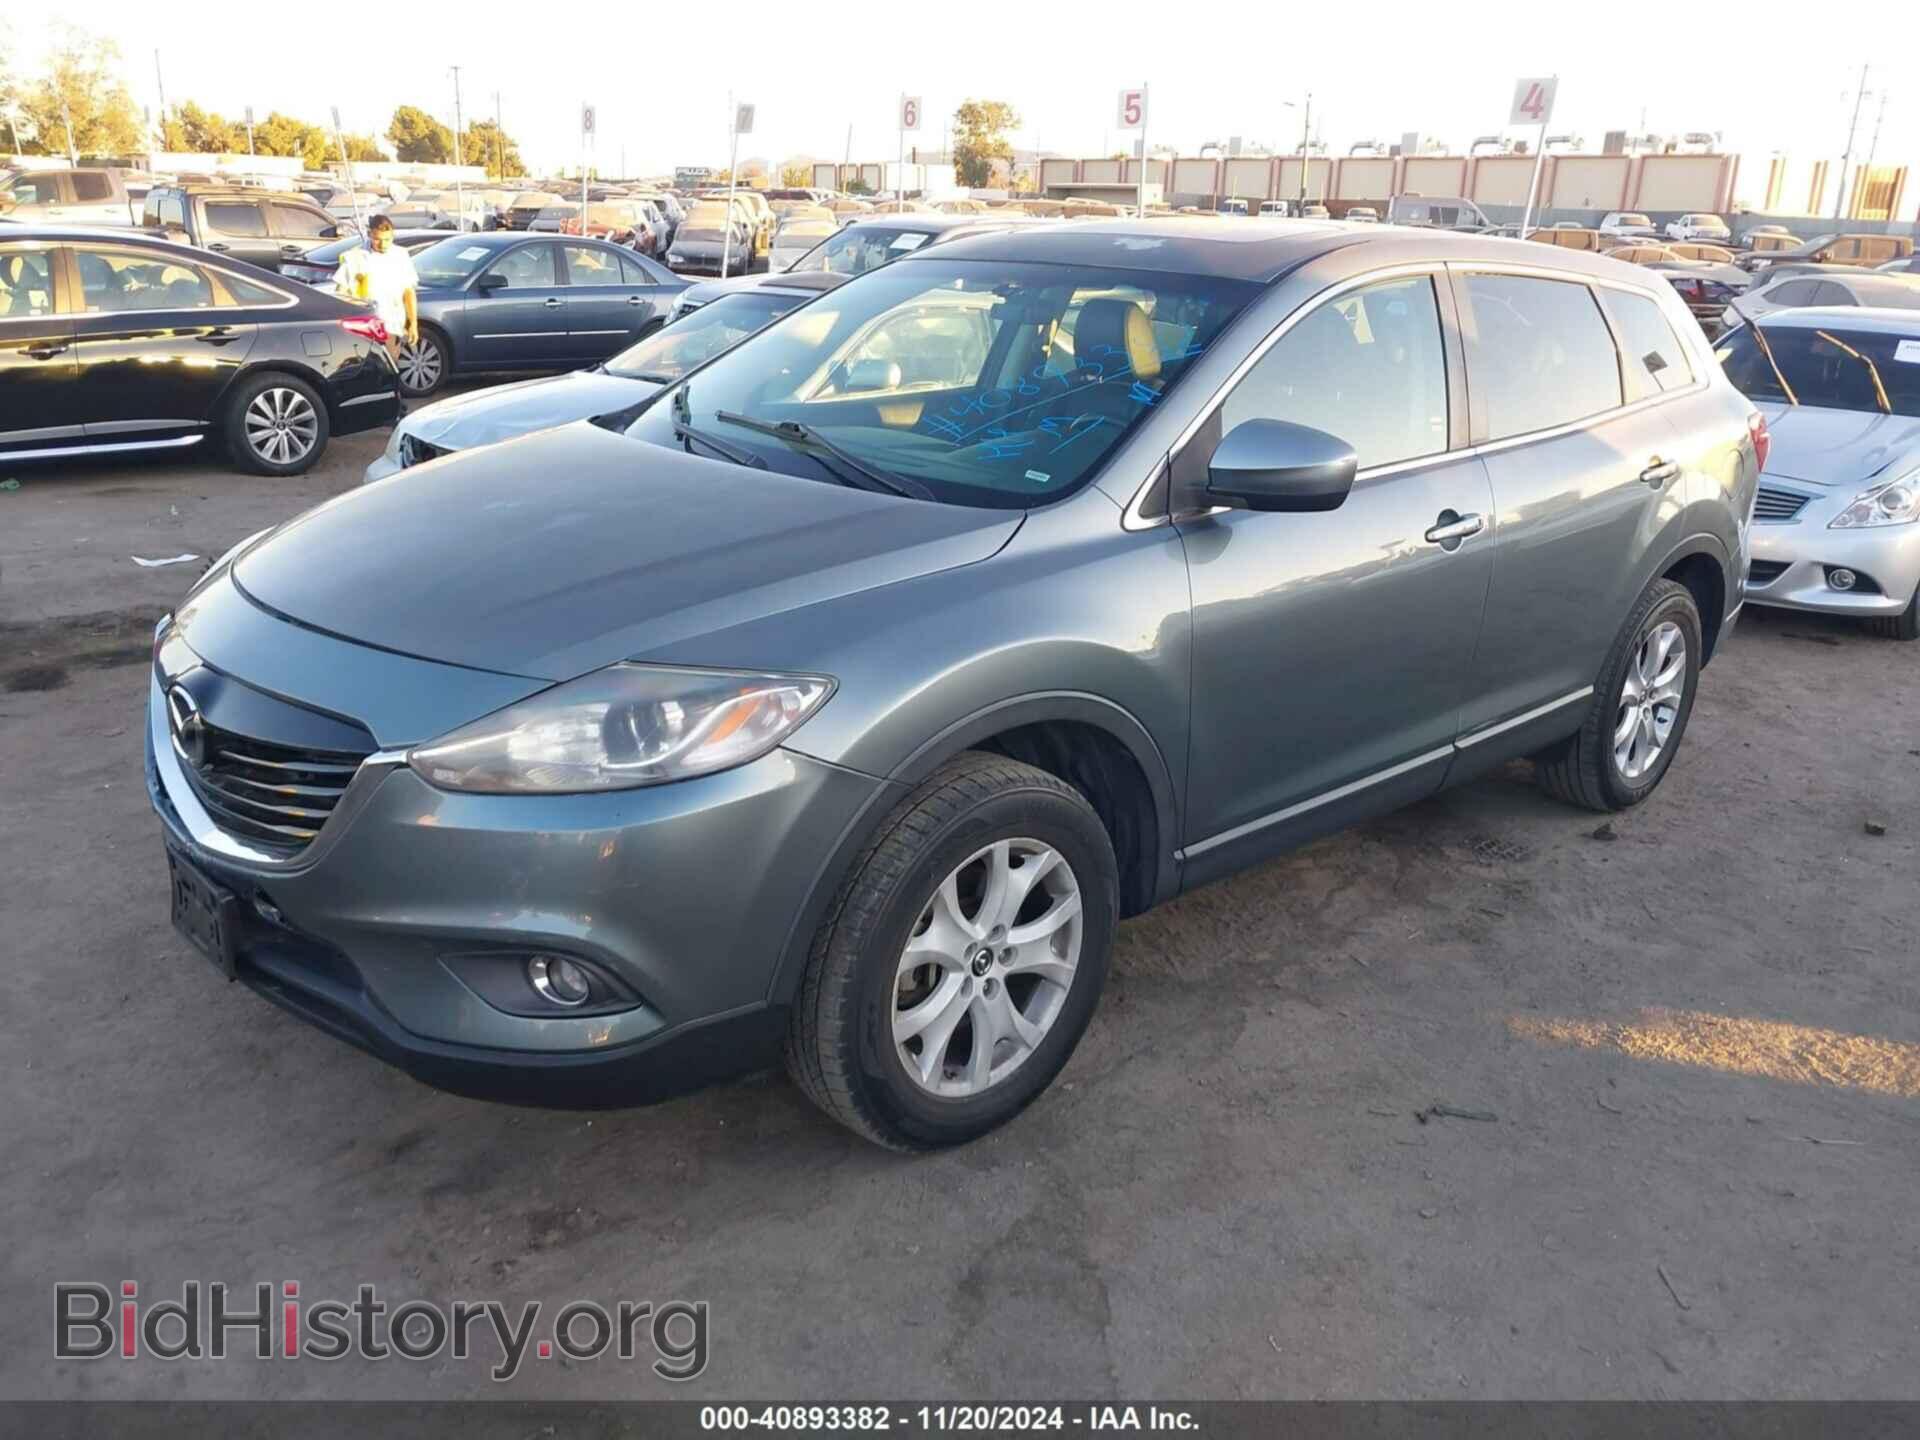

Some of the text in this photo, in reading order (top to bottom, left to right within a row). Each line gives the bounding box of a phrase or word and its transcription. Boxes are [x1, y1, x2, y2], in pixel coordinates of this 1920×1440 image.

[904, 100, 917, 128] 6
[1125, 93, 1141, 124] 5
[1520, 82, 1545, 119] 4
[583, 109, 593, 130] 8
